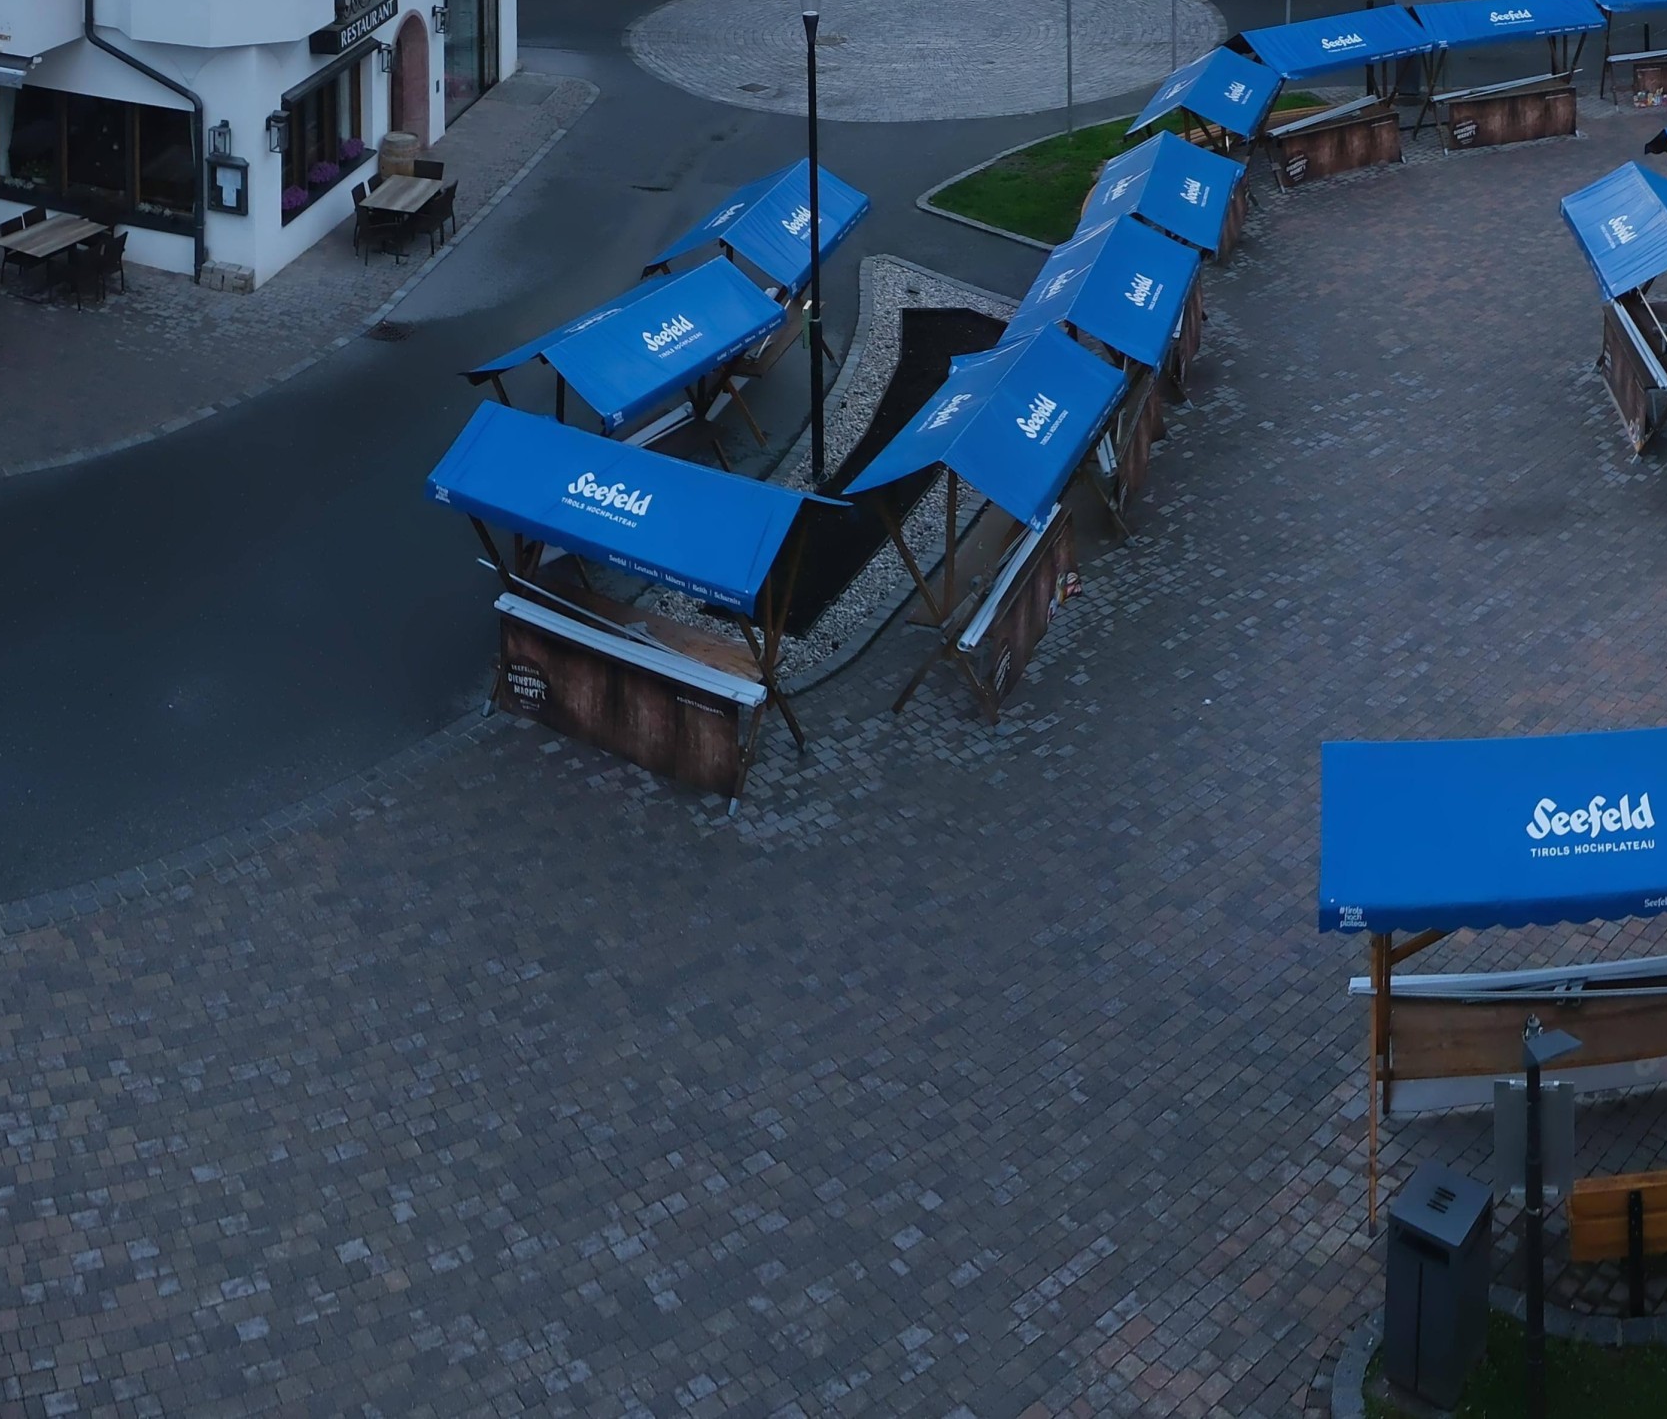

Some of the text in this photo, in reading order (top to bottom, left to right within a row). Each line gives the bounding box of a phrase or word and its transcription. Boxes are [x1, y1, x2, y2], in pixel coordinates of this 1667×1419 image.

[340, 0, 394, 49] RESTAURANT
[1490, 9, 1533, 22] Seefeld
[1321, 33, 1363, 50] Seefeld
[1608, 215, 1638, 245] Seefeld
[1124, 273, 1153, 307] Seefeld
[642, 313, 694, 353] Seefeld
[1016, 393, 1057, 439] Seefeld
[561, 496, 637, 529] TIROLS HOCHPLATEAU
[568, 471, 653, 517] Seefeld
[609, 554, 742, 607] Seefeld Leutasch Mösern Reith Scharnitz
[1525, 791, 1656, 840] Seefeld
[1529, 839, 1656, 858] TIROLS HOCHPLATEAU
